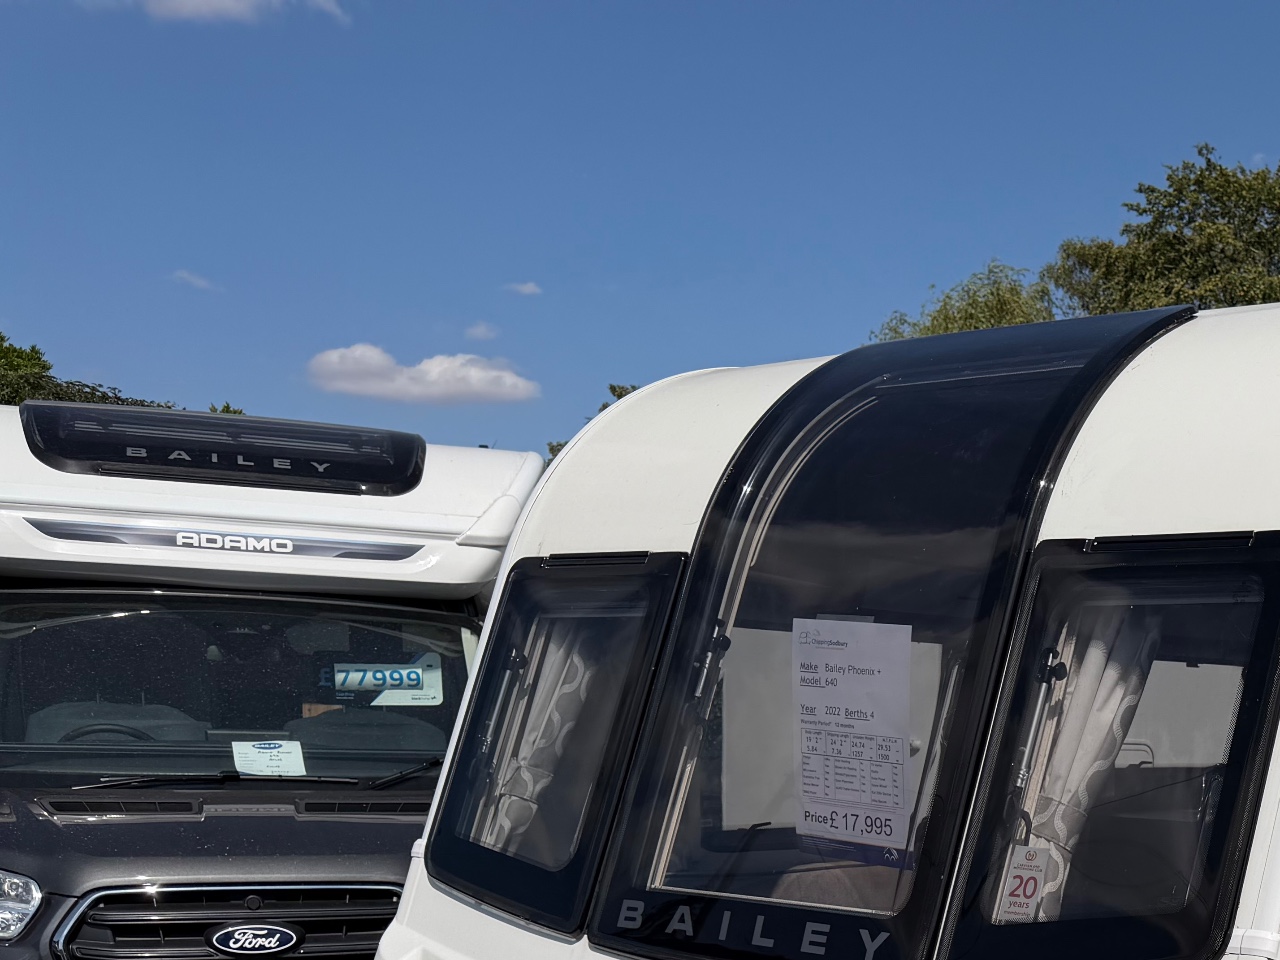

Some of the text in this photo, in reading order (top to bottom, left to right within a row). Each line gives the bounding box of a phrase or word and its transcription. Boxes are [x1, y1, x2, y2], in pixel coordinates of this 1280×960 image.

[126, 446, 331, 473] BAILEY
[176, 531, 294, 553] ADAMO
[800, 662, 819, 671] Make
[825, 663, 846, 675] Bailey
[847, 664, 876, 676] Phoenix
[800, 676, 838, 687] Model 640
[800, 704, 875, 719] Year 2022 Berths 4
[804, 811, 829, 824] Price
[1008, 875, 1038, 899] 20
[1007, 901, 1030, 909] years
[229, 929, 281, 949] Ford
